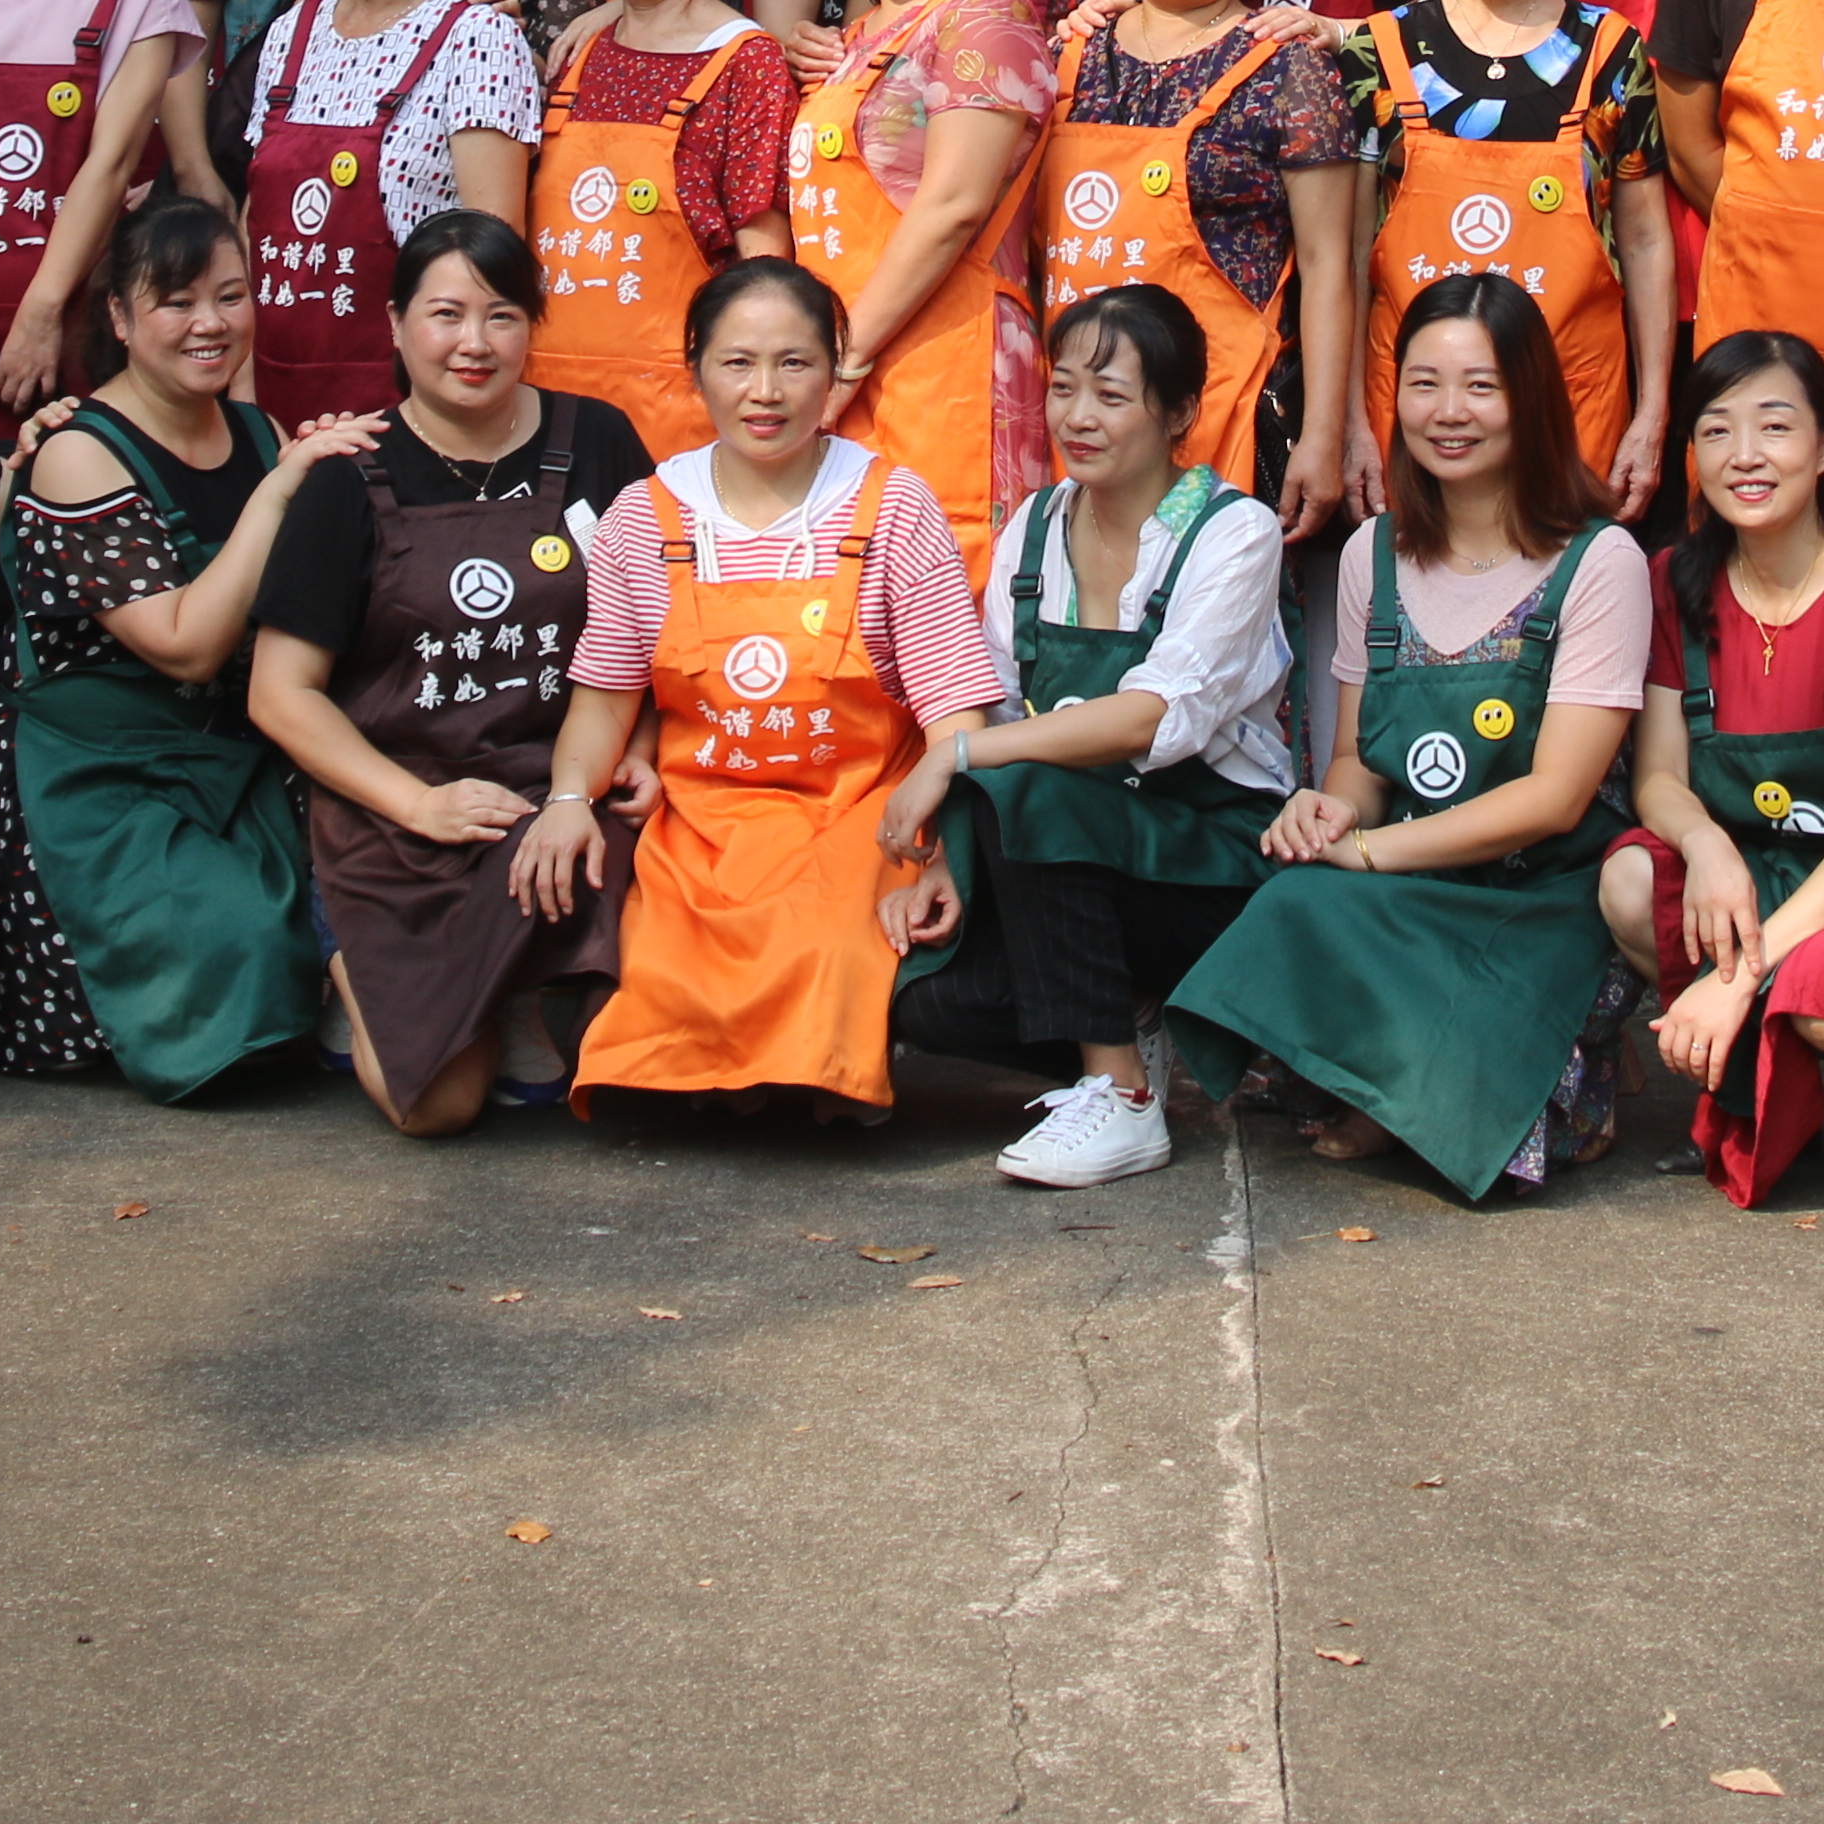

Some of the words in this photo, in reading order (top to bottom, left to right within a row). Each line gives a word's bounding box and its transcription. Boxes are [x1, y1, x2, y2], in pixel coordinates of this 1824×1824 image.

[259, 234, 356, 276] 和谐邻里
[537, 226, 644, 263] 和谐邻里
[256, 272, 356, 317] 亲如一家
[413, 623, 561, 664] 和谐邻里
[413, 664, 561, 711] 亲如一家
[695, 699, 835, 741] 和谐邻里
